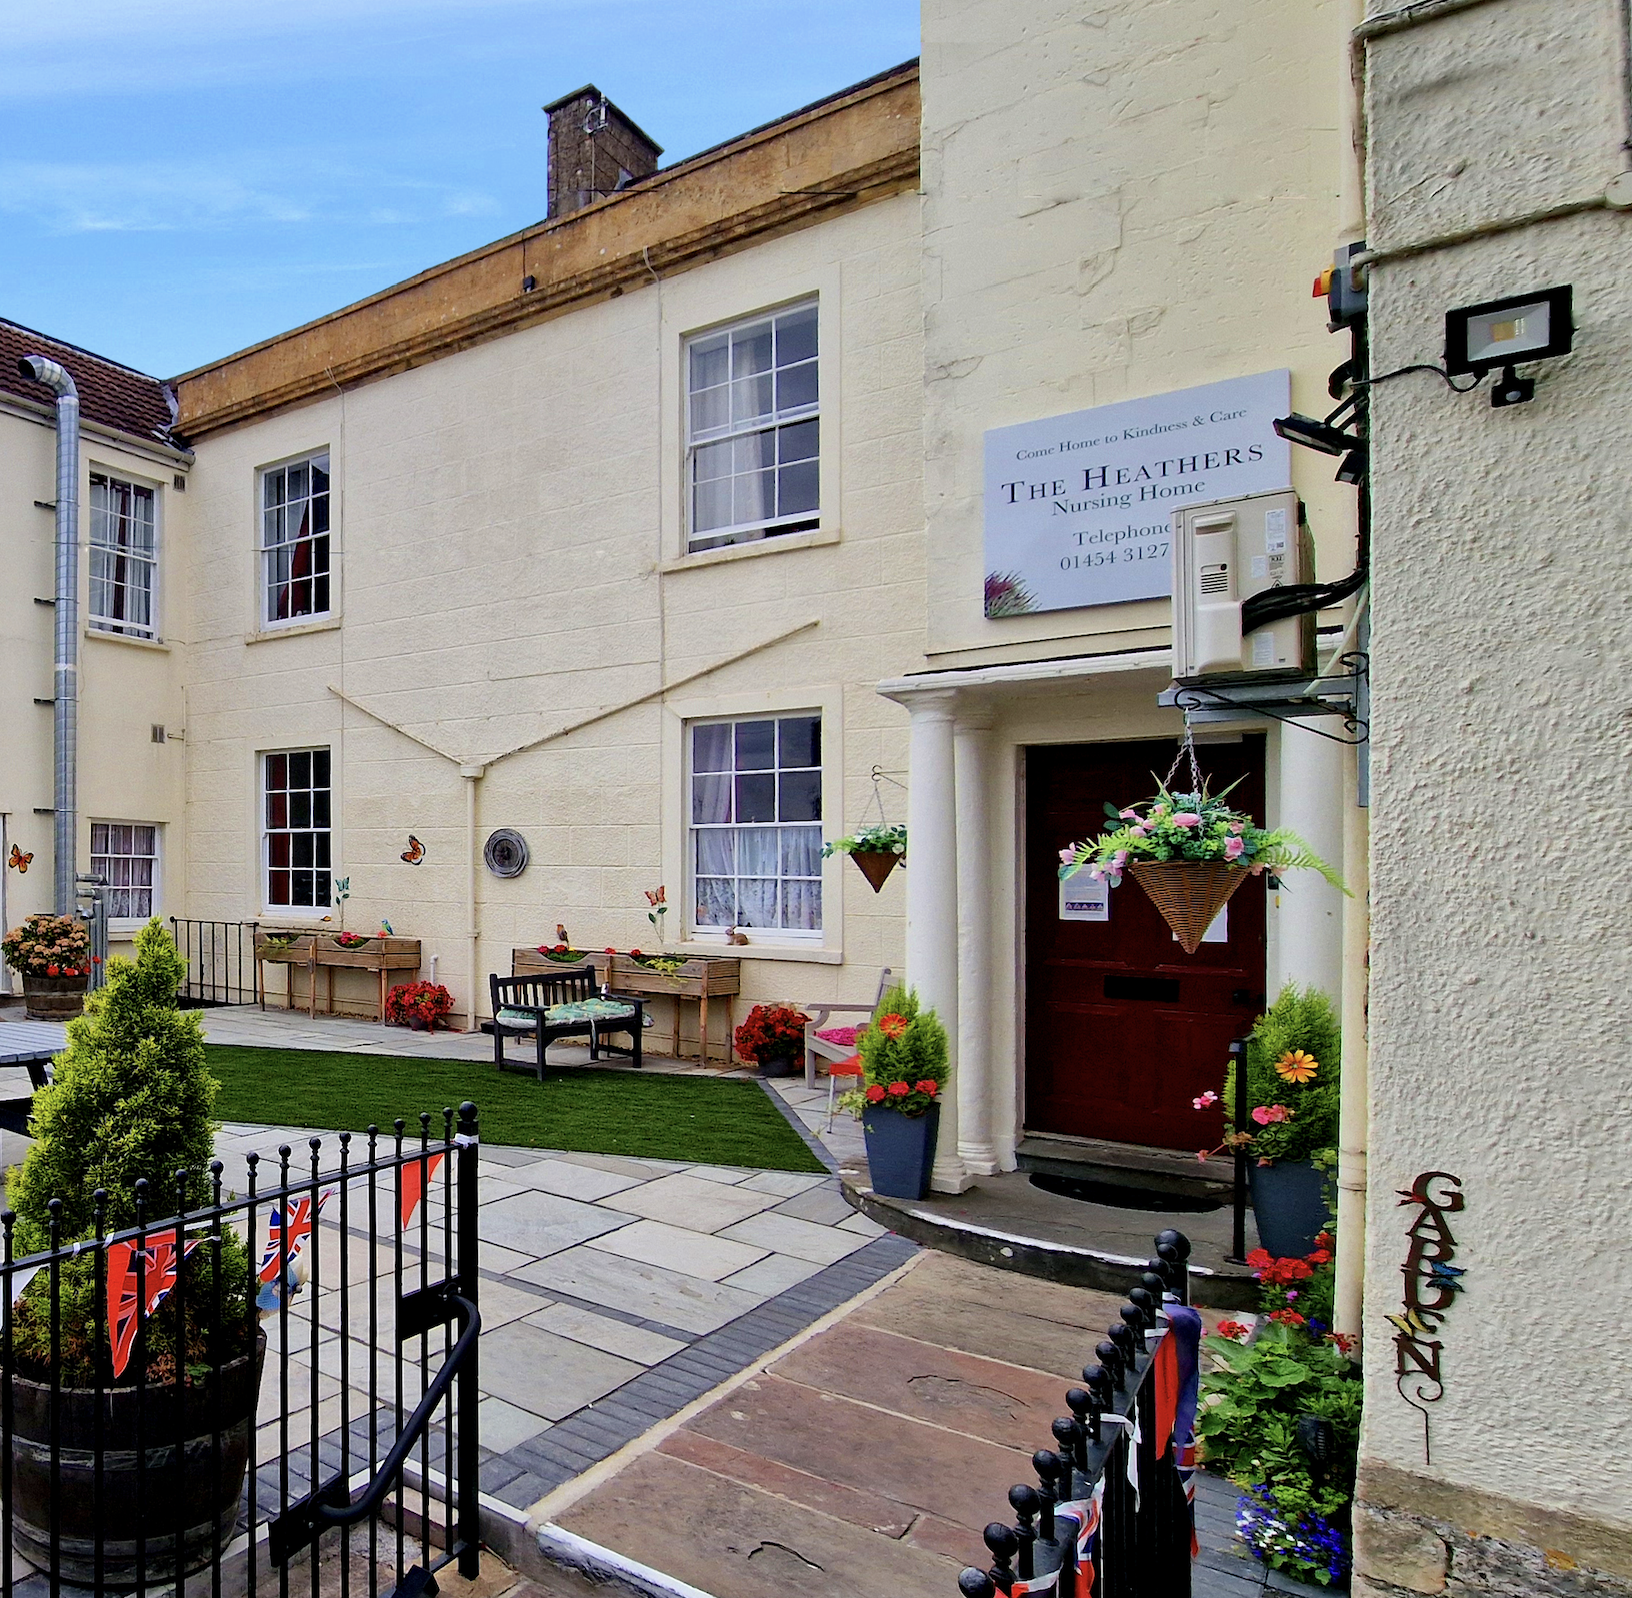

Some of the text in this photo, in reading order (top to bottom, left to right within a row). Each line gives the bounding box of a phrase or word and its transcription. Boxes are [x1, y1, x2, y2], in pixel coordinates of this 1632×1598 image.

[1016, 409, 1247, 461] Come Home to Kindness & Care
[1001, 443, 1264, 505] THE HEATHERS
[1051, 481, 1206, 517] Nursing Home
[1060, 550, 1117, 571] 01454
